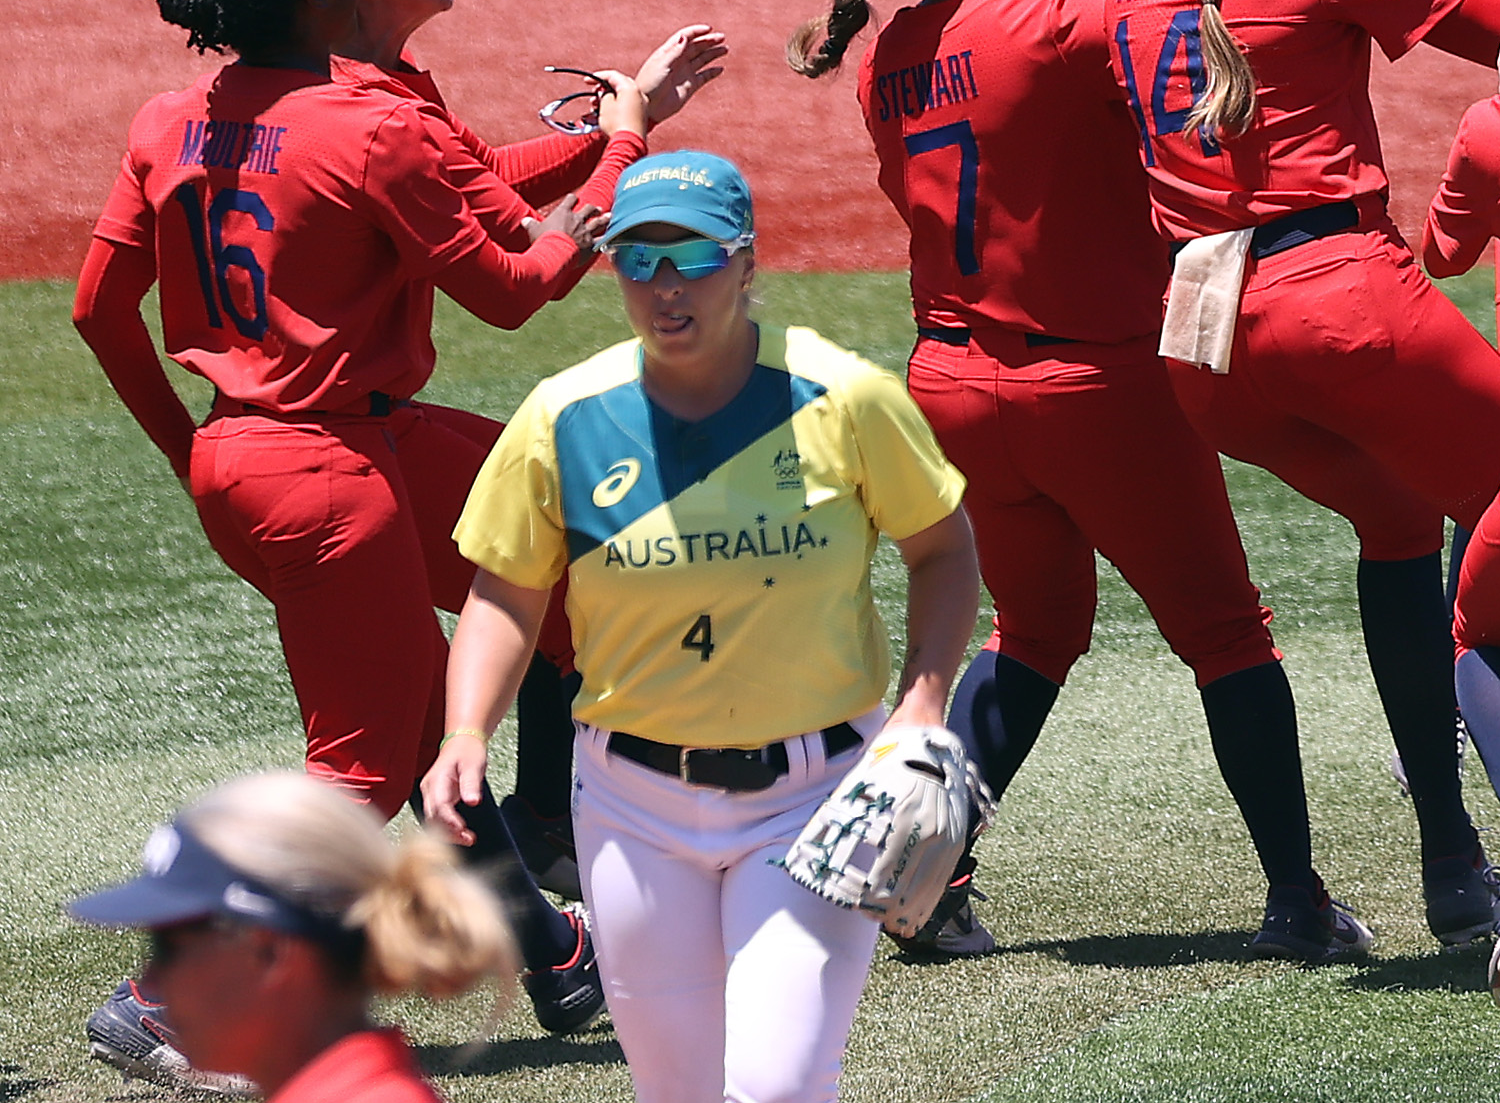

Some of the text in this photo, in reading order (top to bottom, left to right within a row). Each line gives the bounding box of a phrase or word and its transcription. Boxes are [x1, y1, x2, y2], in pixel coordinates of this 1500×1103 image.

[877, 50, 979, 122] STEWART
[1114, 8, 1221, 168] 14
[177, 120, 287, 175] MOULTRIE
[622, 166, 706, 191] AUSTRALIA
[903, 119, 981, 276] 7
[175, 182, 275, 342] 16
[604, 522, 816, 570] AUSTRALIA
[681, 614, 715, 662] 4
